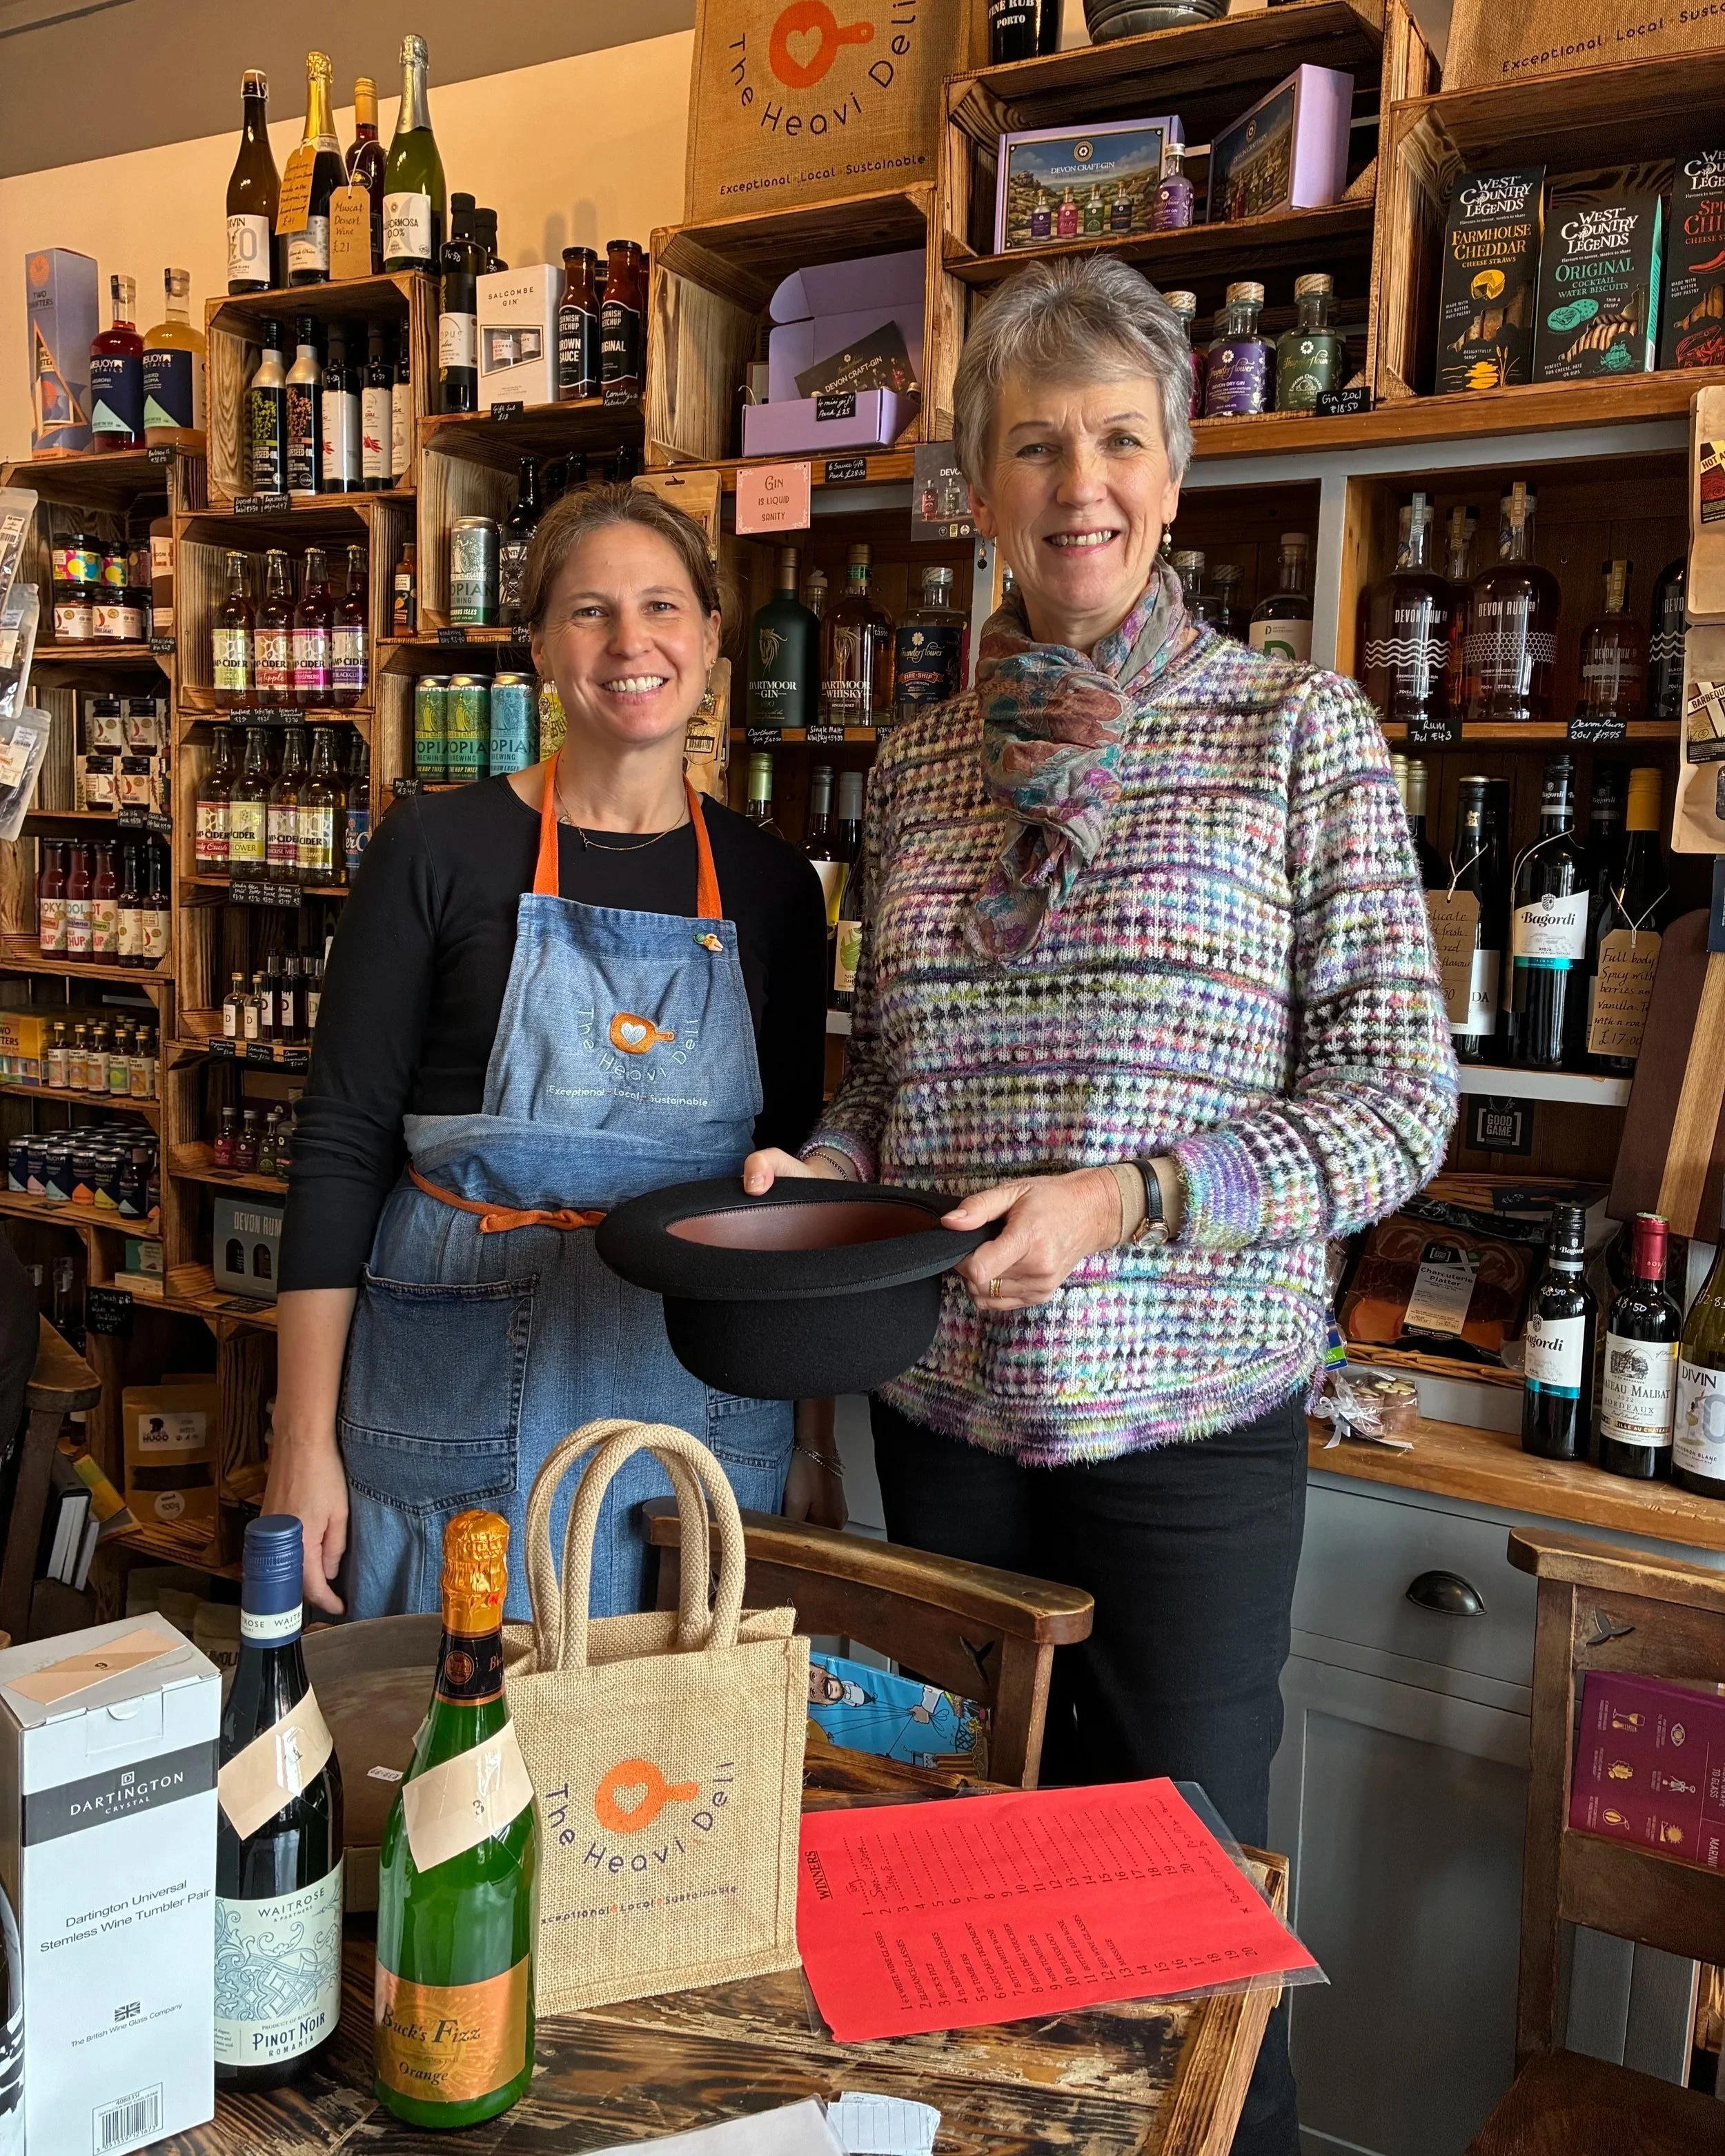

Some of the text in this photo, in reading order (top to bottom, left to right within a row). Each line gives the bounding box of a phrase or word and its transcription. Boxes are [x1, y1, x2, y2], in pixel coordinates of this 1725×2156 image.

[996, 14, 1026, 29] PORTO
[1502, 18, 1664, 72] Exceptional Local
[729, 0, 916, 136] The Heavi Deli
[720, 155, 926, 195] Exceptional Local Sustainable
[1051, 161, 1075, 175] DEVON
[1476, 175, 1518, 192] WEST
[1460, 183, 1533, 206] COUNTRY
[335, 203, 364, 213] Muscat
[1465, 199, 1524, 217] LEGENDS
[335, 215, 361, 226] Dessert
[1579, 208, 1623, 225] WEST
[336, 227, 354, 235] Wine
[1451, 224, 1532, 246] FARMHOUSE
[1561, 215, 1639, 240] COUNTRY
[333, 241, 351, 254] £21
[1566, 233, 1629, 255] LEGENDS
[1685, 237, 1717, 245] CHEESE
[1454, 239, 1526, 261] CHEDDAR
[1461, 256, 1517, 268] CHEESE STRAWS
[1555, 257, 1635, 282] ORIGINAL
[1572, 277, 1615, 288] COCKTAIL
[33, 290, 47, 299] TWO
[488, 286, 534, 300] SALCOMBE
[1558, 282, 1629, 299] WATER BISCUITS
[559, 350, 579, 363] SAUCE
[824, 355, 883, 393] DEVON CRAFT-GIN
[838, 394, 856, 410] gift
[1321, 391, 1361, 404] Gin 20cl
[493, 404, 505, 414] Gift
[497, 412, 509, 421] £18
[818, 407, 851, 418] Pack £25
[834, 458, 864, 470] Sauce Gift
[1702, 455, 1717, 470] HOT
[829, 471, 844, 479] Pack
[766, 495, 790, 507] LIQUID
[761, 512, 785, 522] SANITY
[463, 608, 477, 616] ISLES
[1478, 600, 1526, 617] DEVON RUM
[1395, 609, 1441, 624] DEVON RUM
[1595, 647, 1614, 660] DEVON
[222, 659, 248, 668] CIDER
[262, 660, 286, 669] CIDER
[300, 660, 325, 669] CIDER
[749, 680, 797, 691] DARTMOOR
[822, 680, 871, 691] DARTMOOR
[760, 690, 778, 699] GIN
[826, 689, 864, 699] WHISKY
[810, 725, 843, 735] Single Malt
[1573, 719, 1626, 730] Devon Rum
[807, 733, 828, 742] Whisky
[1571, 730, 1590, 740] 20cl
[205, 831, 230, 840] CIDER
[233, 831, 255, 840] CIDER
[299, 838, 323, 846] CIDER
[207, 844, 228, 852] Crush
[1521, 911, 1576, 928] Bagordi
[1602, 948, 1628, 963] Full
[1602, 967, 1630, 984] Spicy
[1471, 991, 1490, 1003] DA
[1599, 984, 1636, 996] berries
[578, 1008, 700, 1081] The Heavi Deli
[548, 1085, 708, 1107] Exceptional Local Sustainable
[1486, 1114, 1512, 1126] GOOD
[1486, 1125, 1512, 1137] GAME
[234, 1211, 260, 1234] DEVON
[1420, 1267, 1473, 1283] Charcuterie
[1430, 1275, 1461, 1287] Platter
[1682, 1365, 1717, 1389] DIVIN
[1617, 1394, 1635, 1403] 2022
[1631, 1384, 1670, 1399] MALBAT
[1604, 1396, 1655, 1414] BORDEAUX
[1697, 1452, 1717, 1462] BLANC
[70, 1771, 184, 1816] DARTINGTON
[1710, 1777, 1720, 1800] GLASS
[105, 1796, 150, 1814] CRYSTAL
[545, 1762, 735, 1874] The Heavi Deli
[805, 1850, 831, 1900] WINNERS
[65, 1879, 187, 1928] Dartington Universal
[258, 1888, 325, 1918] WAITROSE
[620, 1886, 738, 1912] Local Sustainable
[39, 1889, 211, 1952] Stemless Wine Tumbler Pair
[280, 1906, 313, 1922] PARTNERS
[874, 1932, 889, 1957] GLASSES
[931, 1932, 948, 1958] GLASSES
[965, 1922, 987, 1957] TREATMENT
[1003, 1923, 1021, 1952] VOUCHER
[1045, 1932, 1073, 1974] REFLEXOLOGY
[1105, 1939, 1127, 1966] MASSAGE
[896, 1939, 929, 2001] ELEGANCE GLASSES
[960, 1953, 980, 1985] TUMBLERS
[1005, 1966, 1022, 1988] BOTTLE
[71, 2003, 183, 2048] The British Wine Glass Company
[253, 2029, 297, 2051] PINOT
[299, 2012, 325, 2040] NOIR
[262, 2019, 288, 2030] PRODUCT
[382, 2004, 481, 2044] Buck's Fizz
[269, 2036, 315, 2057] ROMANIA
[399, 2061, 448, 2084] Orange
